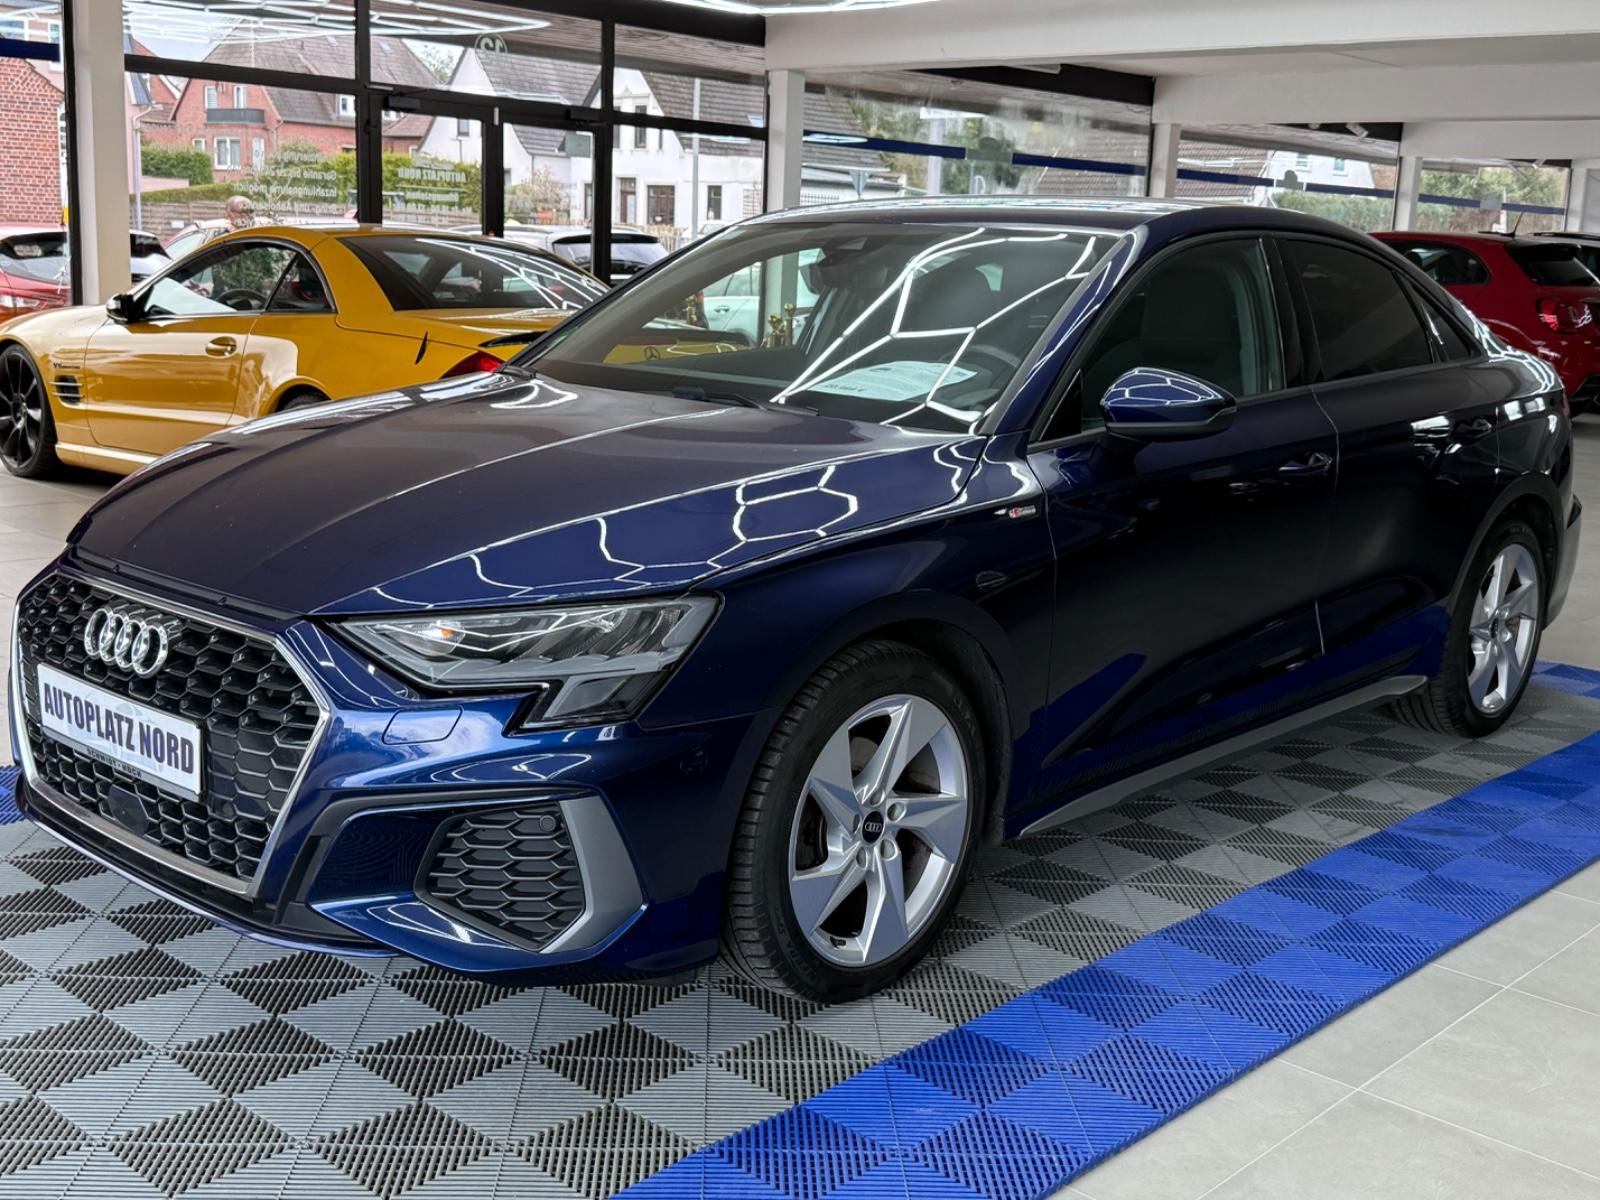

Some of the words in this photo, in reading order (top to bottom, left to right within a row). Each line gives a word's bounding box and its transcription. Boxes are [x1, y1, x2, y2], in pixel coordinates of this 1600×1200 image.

[44, 682, 135, 751] AUTOPLATZ
[139, 721, 194, 774] NORD
[87, 747, 117, 767] SCHMIDT
